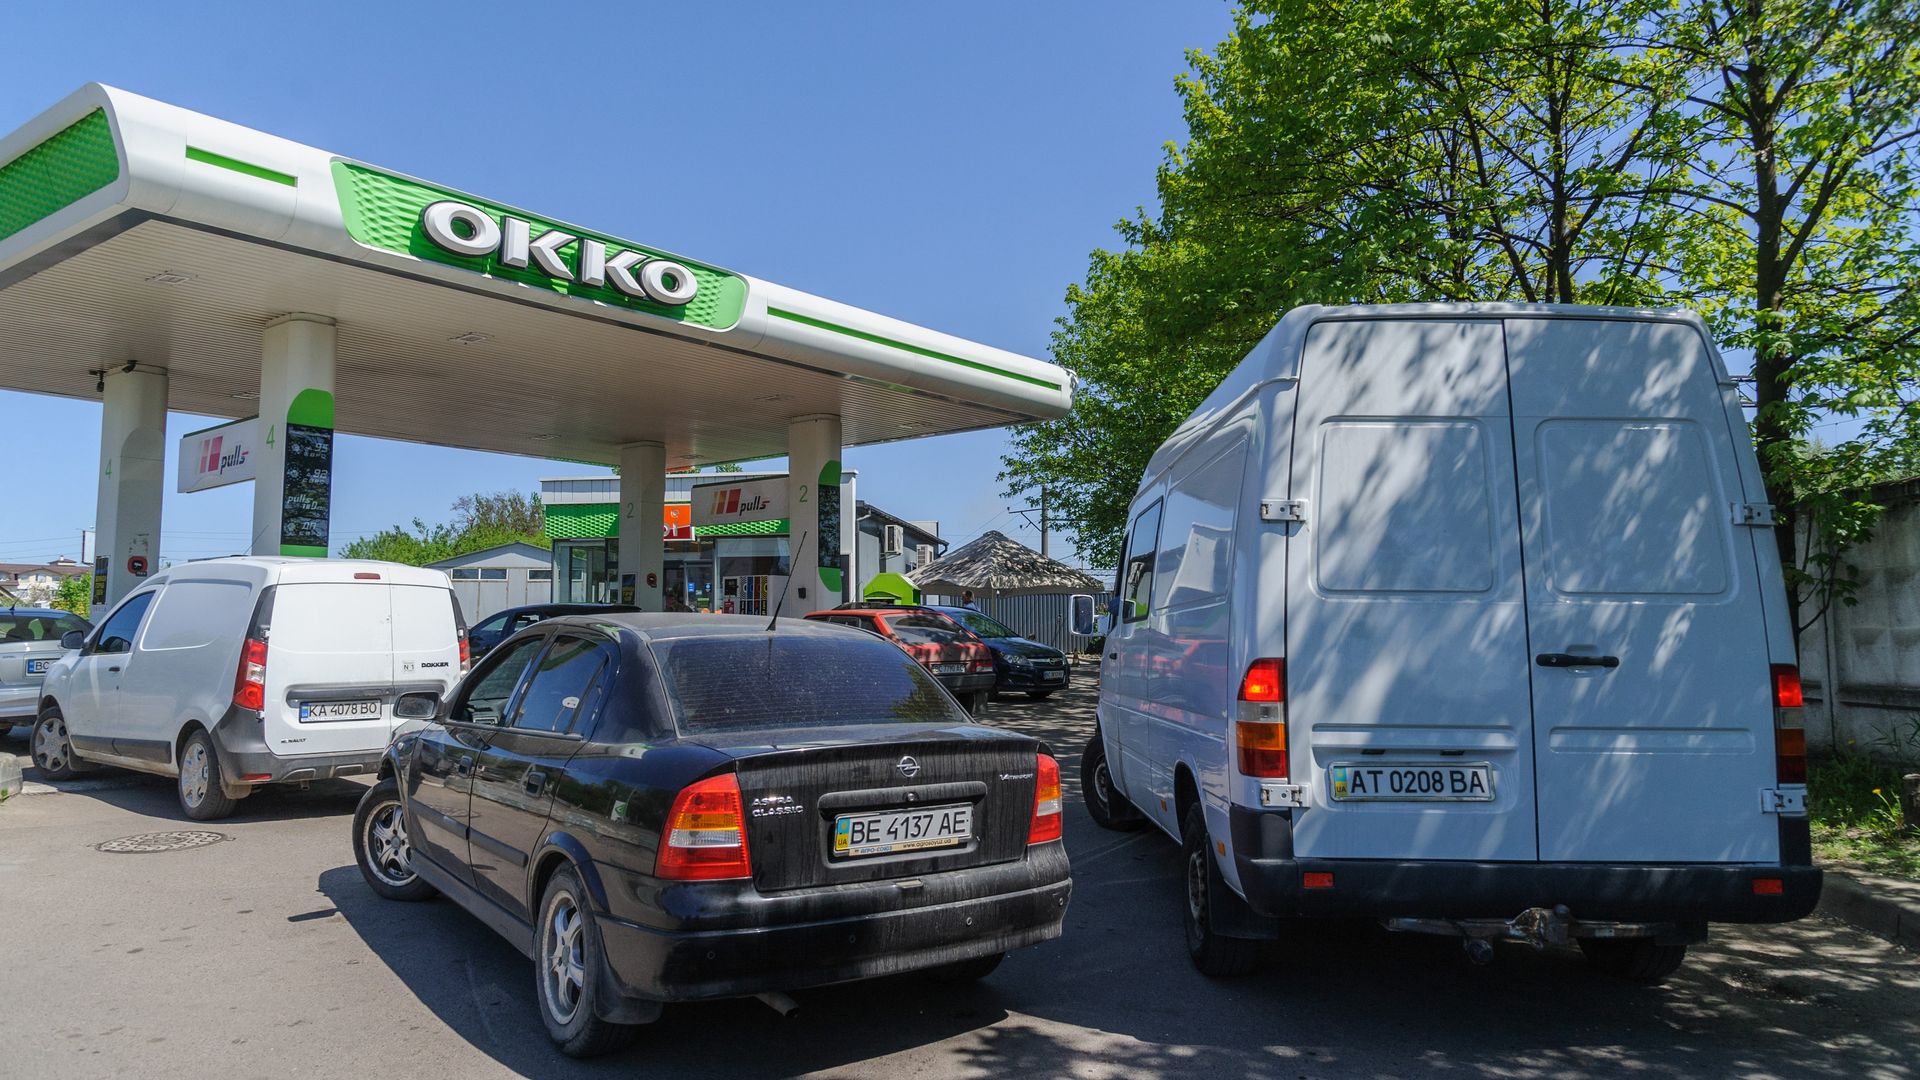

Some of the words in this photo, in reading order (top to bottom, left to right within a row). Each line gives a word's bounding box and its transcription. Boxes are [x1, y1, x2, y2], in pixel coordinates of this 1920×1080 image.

[419, 199, 699, 305] OKKO
[266, 424, 276, 449] 4
[105, 458, 113, 480] 4
[219, 444, 249, 475] pulls
[799, 485, 808, 502] 2
[626, 502, 634, 518] 2
[739, 495, 771, 516] pulls
[309, 704, 327, 717] KA
[330, 703, 358, 716] 4078
[360, 702, 377, 714] BO
[1350, 770, 1384, 794] AT
[1389, 770, 1445, 794] 0208
[1449, 770, 1485, 794] BA
[751, 795, 794, 806] ASTRA
[752, 805, 804, 818] CLASSIC
[850, 819, 881, 845] BE
[886, 813, 934, 841] 4137
[937, 810, 967, 836] AE
